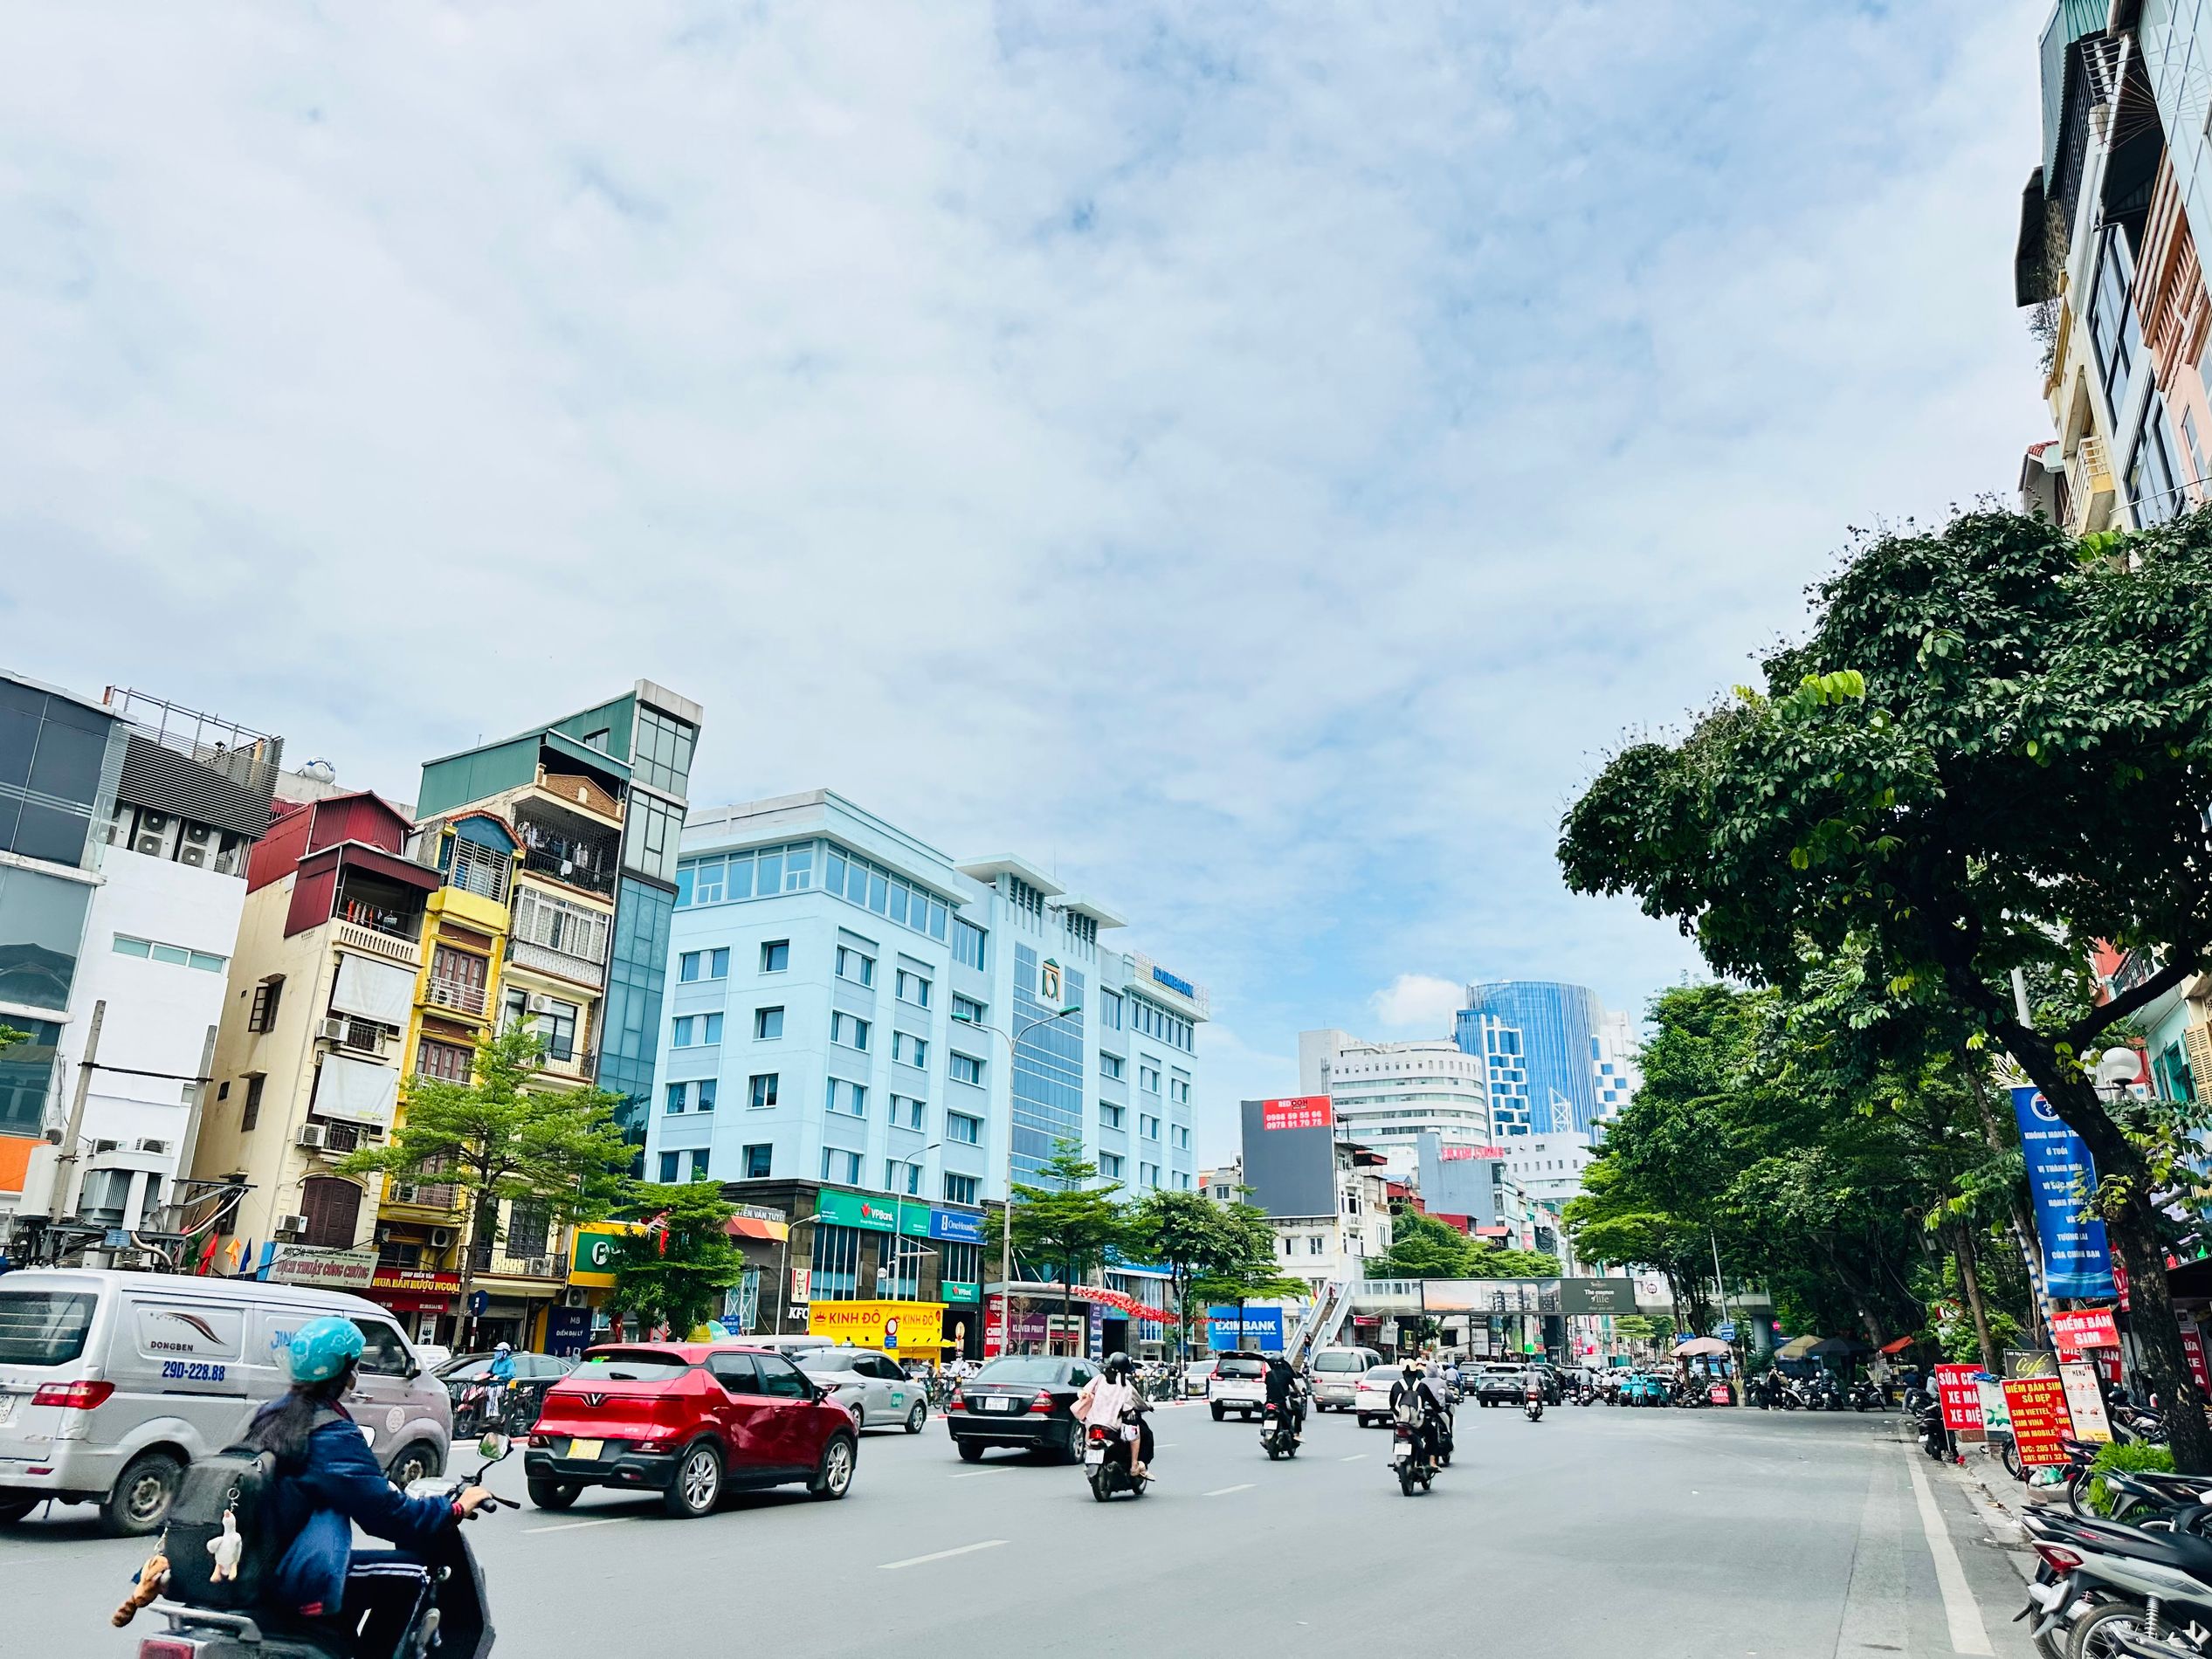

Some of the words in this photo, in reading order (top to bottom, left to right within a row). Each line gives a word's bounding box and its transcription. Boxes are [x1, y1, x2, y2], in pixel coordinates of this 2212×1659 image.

[870, 1208, 894, 1222] VPBank
[372, 1277, 391, 1288] MUA
[391, 1277, 410, 1289] BÁN
[410, 1279, 435, 1292] RƯỢU
[435, 1282, 461, 1294] NGOẠI
[788, 1307, 809, 1320] KFC
[830, 1313, 858, 1325] KINH
[862, 1309, 880, 1324] ĐÔ
[903, 1313, 920, 1325] KINH
[922, 1311, 934, 1325] ĐÔ
[2085, 1313, 2112, 1327] BÁN
[1216, 1320, 1276, 1331] EXIMBANK
[2073, 1331, 2101, 1345] SIM
[150, 1341, 194, 1352] DONGBEN
[162, 1360, 225, 1381] 29D-228.88
[2016, 1353, 2050, 1379] Café
[1939, 1368, 1960, 1386] SỬA
[2028, 1381, 2045, 1392] BÁN
[2046, 1381, 2062, 1391] SIM
[1947, 1390, 1961, 1404] XE
[1963, 1388, 1980, 1404] MÁ
[2022, 1392, 2033, 1403] SỐ
[2035, 1394, 2050, 1404] ĐẸP
[1950, 1409, 1963, 1422] XE
[1965, 1407, 1982, 1425] ĐIỆ
[2028, 1418, 2044, 1427] VINA
[2031, 1428, 2056, 1437] MOBILE
